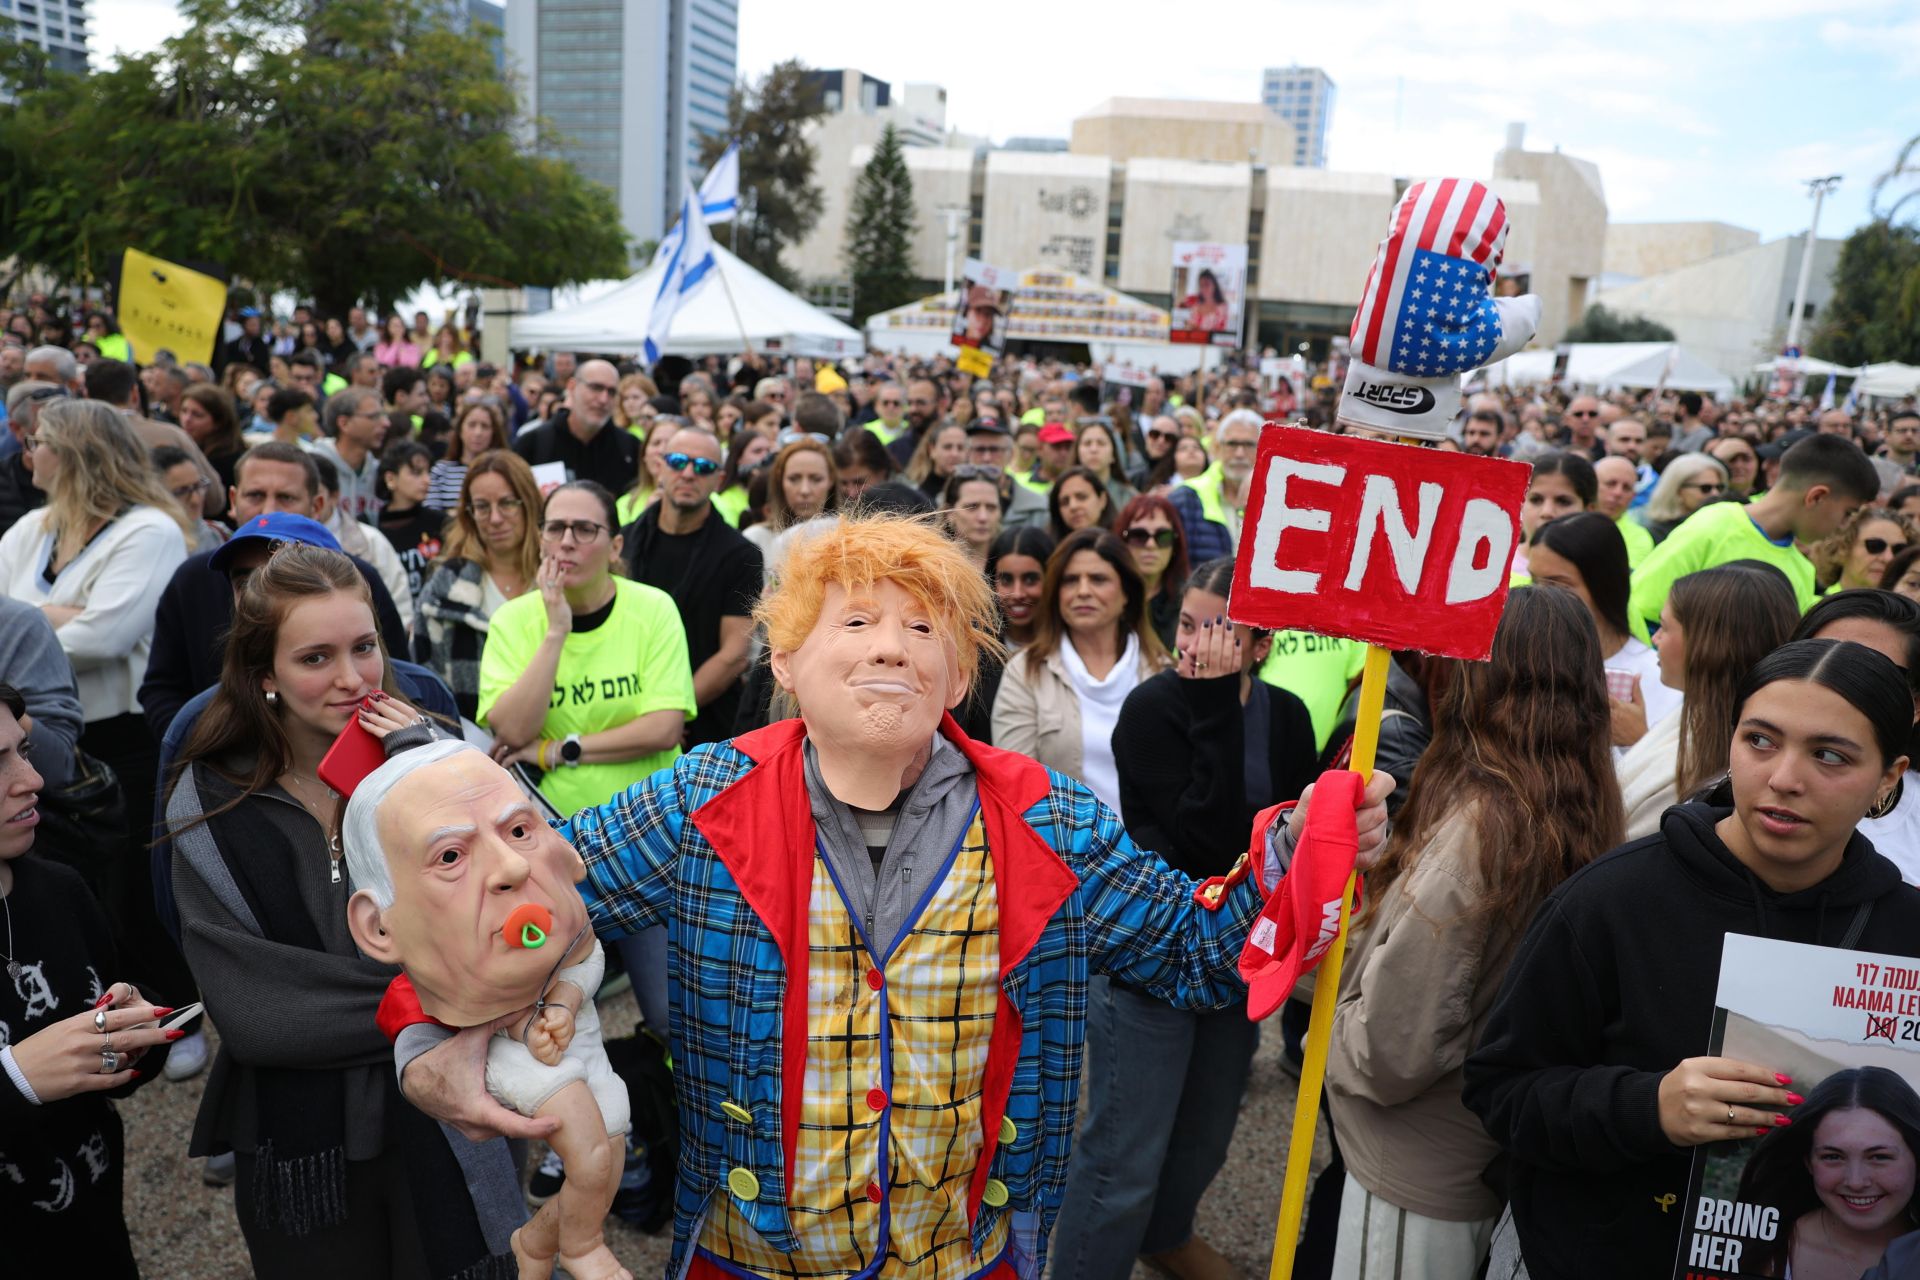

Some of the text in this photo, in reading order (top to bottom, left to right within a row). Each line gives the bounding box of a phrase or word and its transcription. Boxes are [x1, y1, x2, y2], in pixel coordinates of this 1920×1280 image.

[1353, 382, 1419, 406] SPORT
[1250, 456, 1513, 605] END
[1276, 631, 1298, 656] לא
[549, 673, 642, 709] אתם לא ל
[1856, 963, 1879, 986] לוי
[1832, 986, 1920, 1017] NAAMA LE
[1695, 1197, 1780, 1242] BRING
[1689, 1233, 1743, 1274] HER
